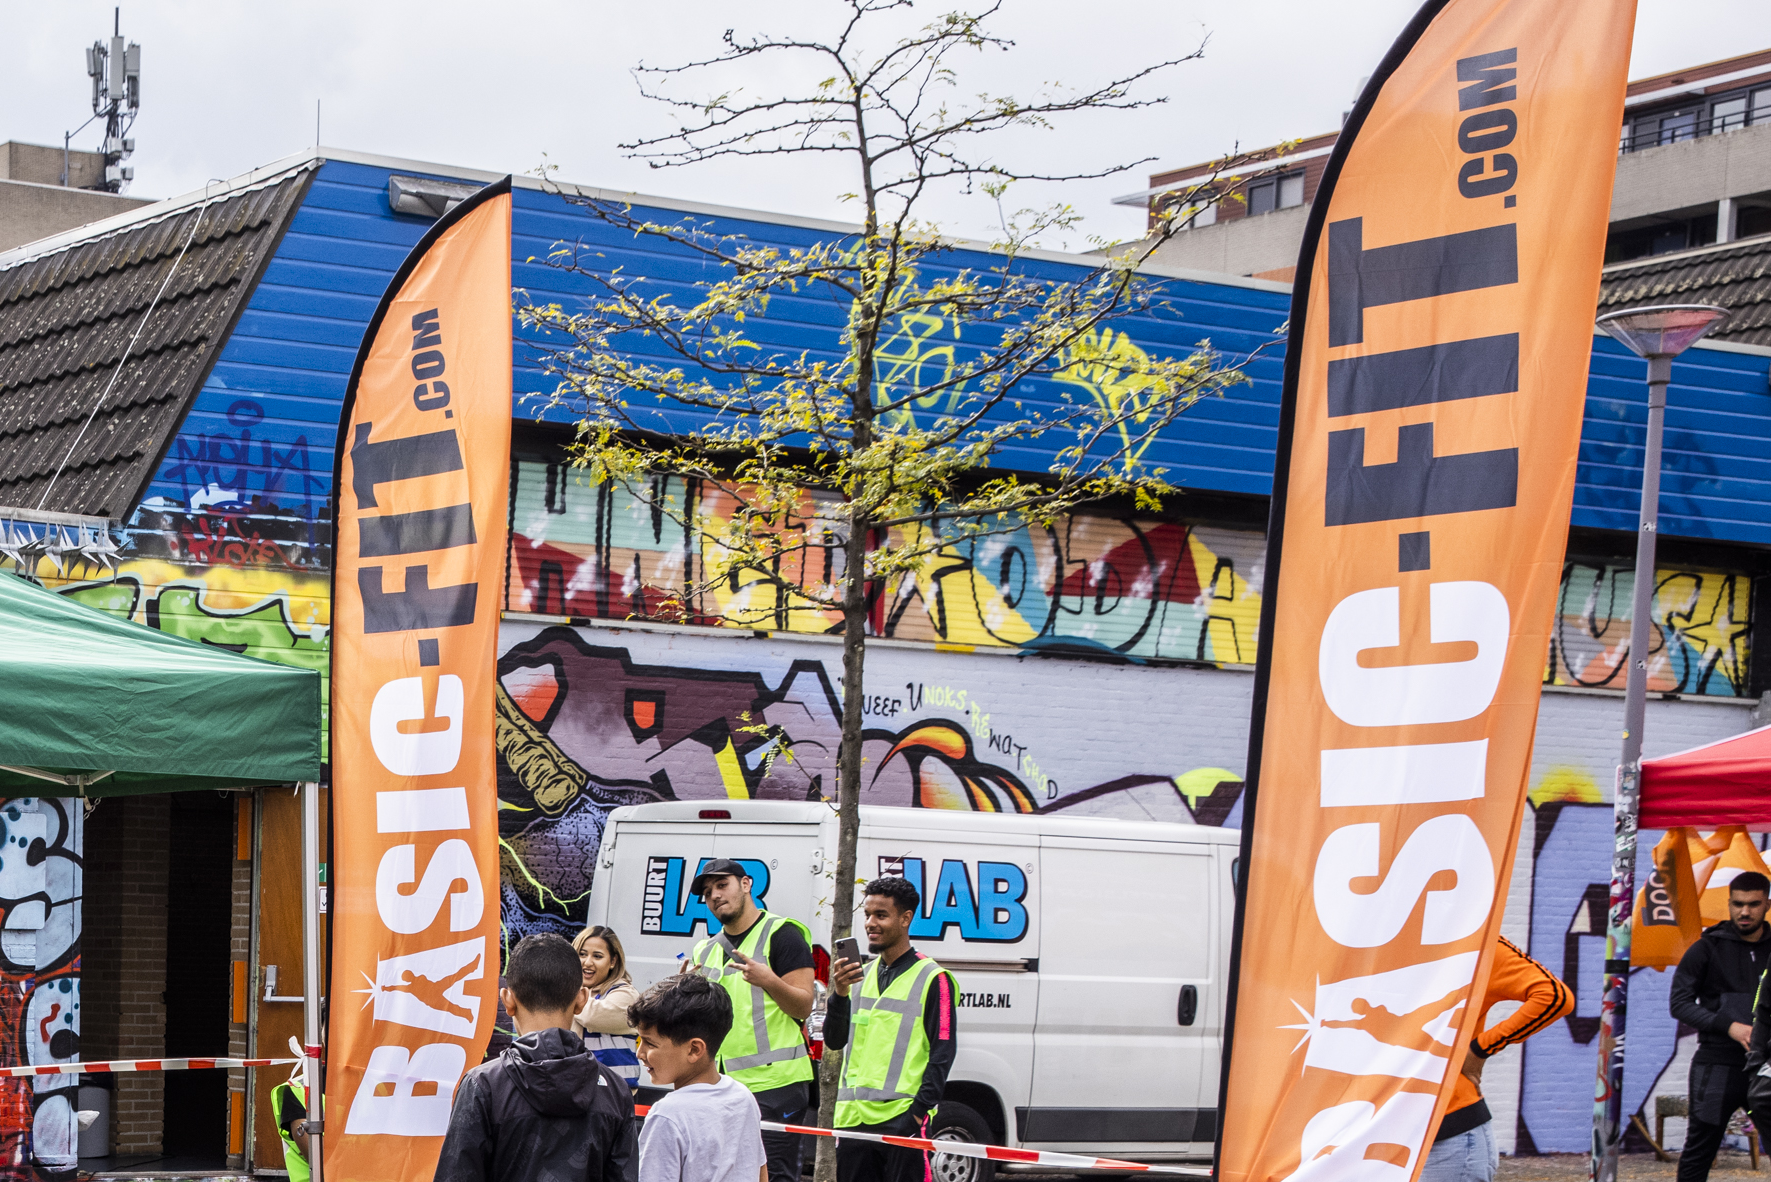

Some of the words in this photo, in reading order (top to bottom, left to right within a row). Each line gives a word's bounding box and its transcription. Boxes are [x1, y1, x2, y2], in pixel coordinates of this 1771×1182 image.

[642, 858, 668, 932] BUURT
[659, 856, 771, 936] LAB
[903, 857, 1029, 943] LAB
[958, 992, 1011, 1009] RTLAB.NL
